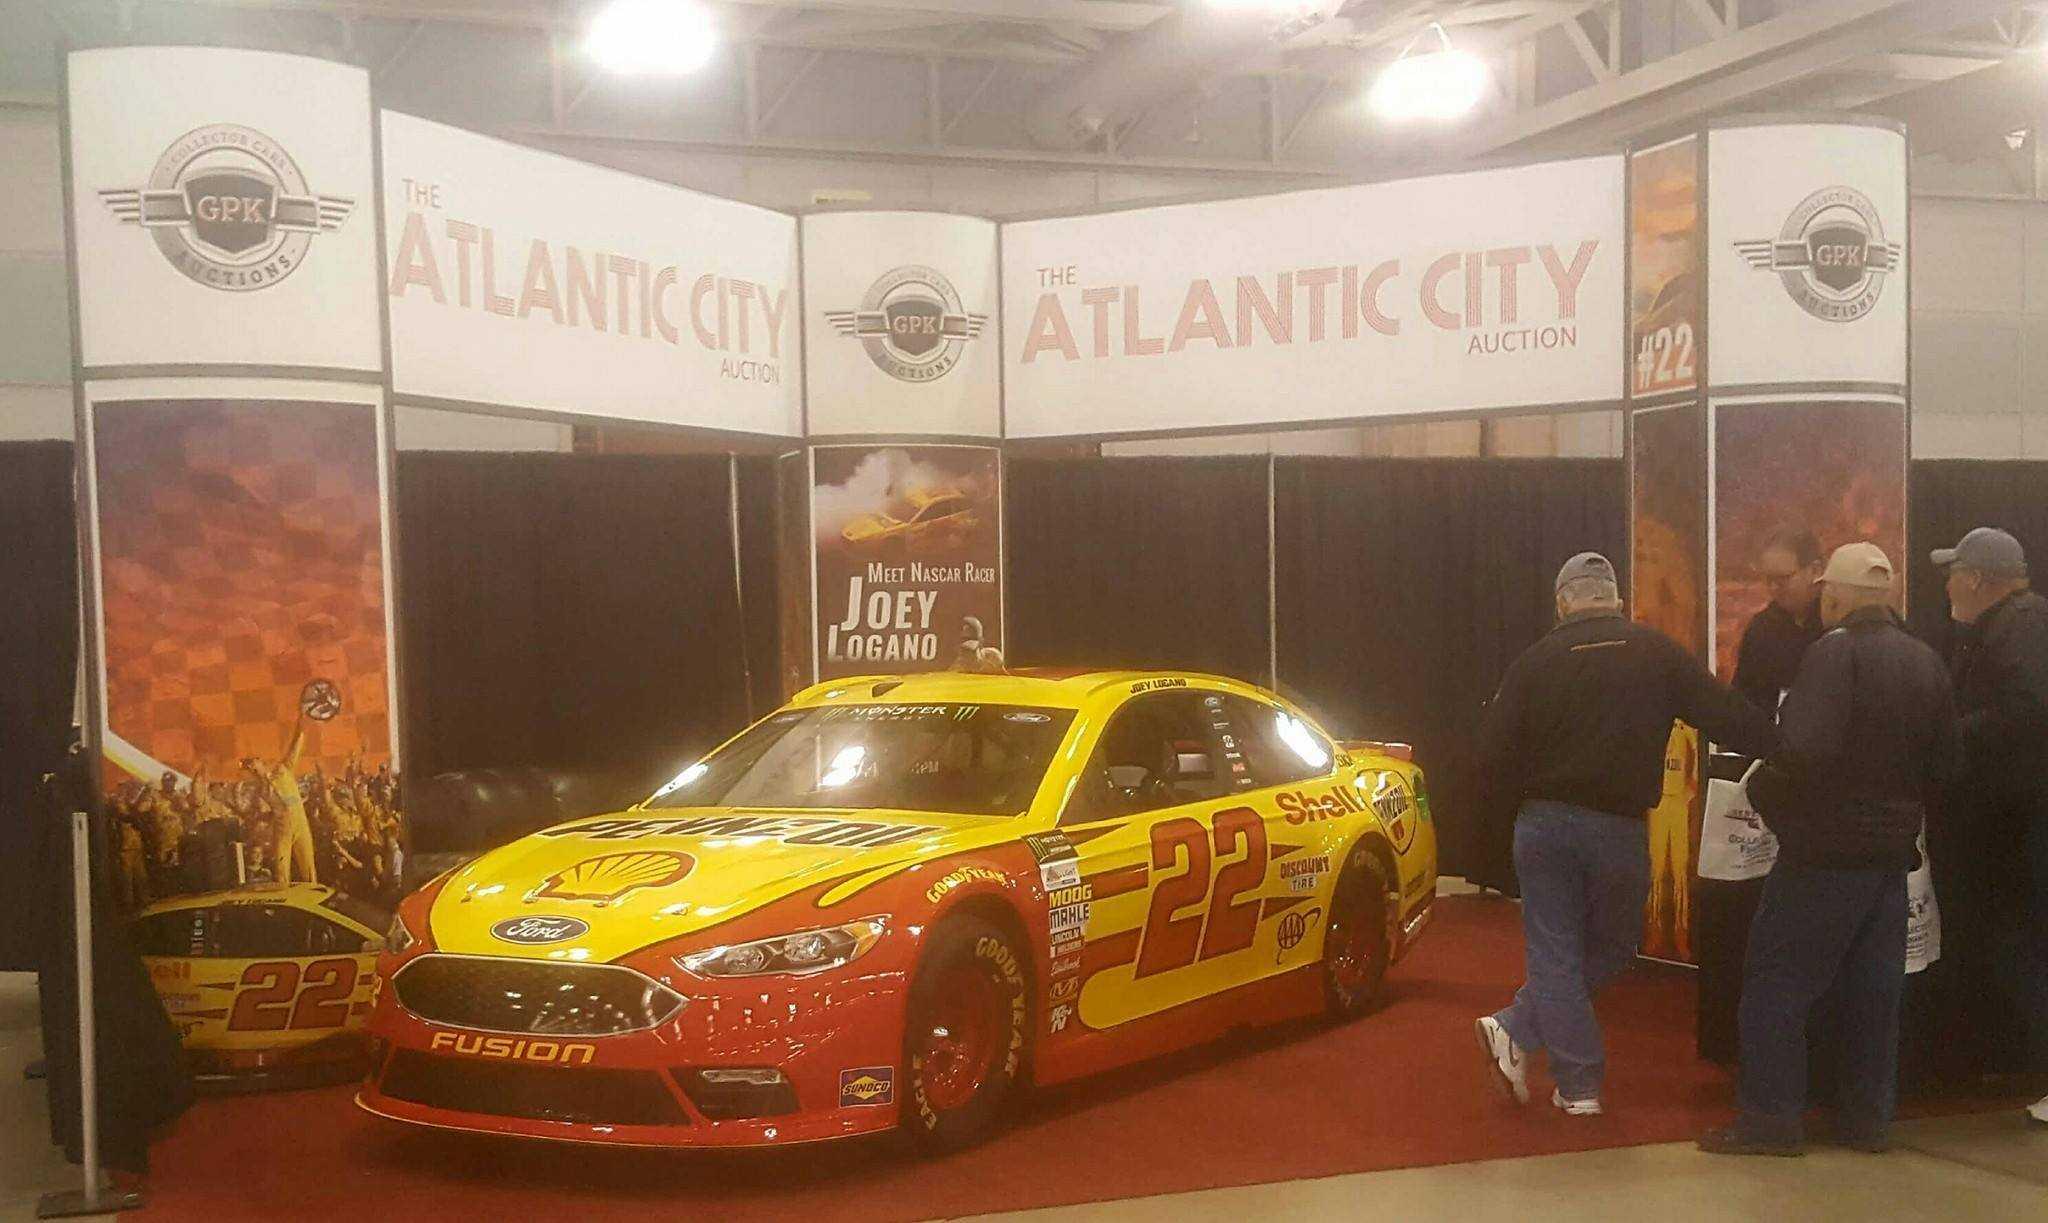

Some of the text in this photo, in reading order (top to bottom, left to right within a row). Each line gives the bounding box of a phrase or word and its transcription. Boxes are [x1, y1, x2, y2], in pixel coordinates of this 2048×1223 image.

[402, 178, 441, 209] THE
[198, 195, 266, 224] GPK
[1816, 244, 1862, 266] GPK
[389, 211, 789, 358] ATLANTIC CITY
[1037, 265, 1077, 288] THE
[1020, 239, 1600, 364] ATLANTIC CITY
[893, 315, 938, 334] GPK
[1467, 326, 1578, 355] AUCTION
[720, 357, 780, 385] AUCTION
[1638, 324, 1695, 389] #22
[840, 576, 938, 632] JOEY
[827, 624, 938, 663] LOGANO
[1130, 678, 1187, 694] JOEY LOGANO
[1275, 784, 1365, 826] Shell
[1280, 855, 1330, 880] DISCOUNT
[926, 866, 1008, 904] GOODYEAR
[1049, 884, 1093, 908] MOOG
[1135, 806, 1267, 980] 22
[1291, 876, 1315, 892] TIRE
[507, 918, 571, 938] Ford
[1050, 902, 1090, 930] MAHLE
[227, 957, 358, 1032] 22
[431, 1031, 596, 1064] FUSION
[842, 1081, 890, 1096] SUNOCO
